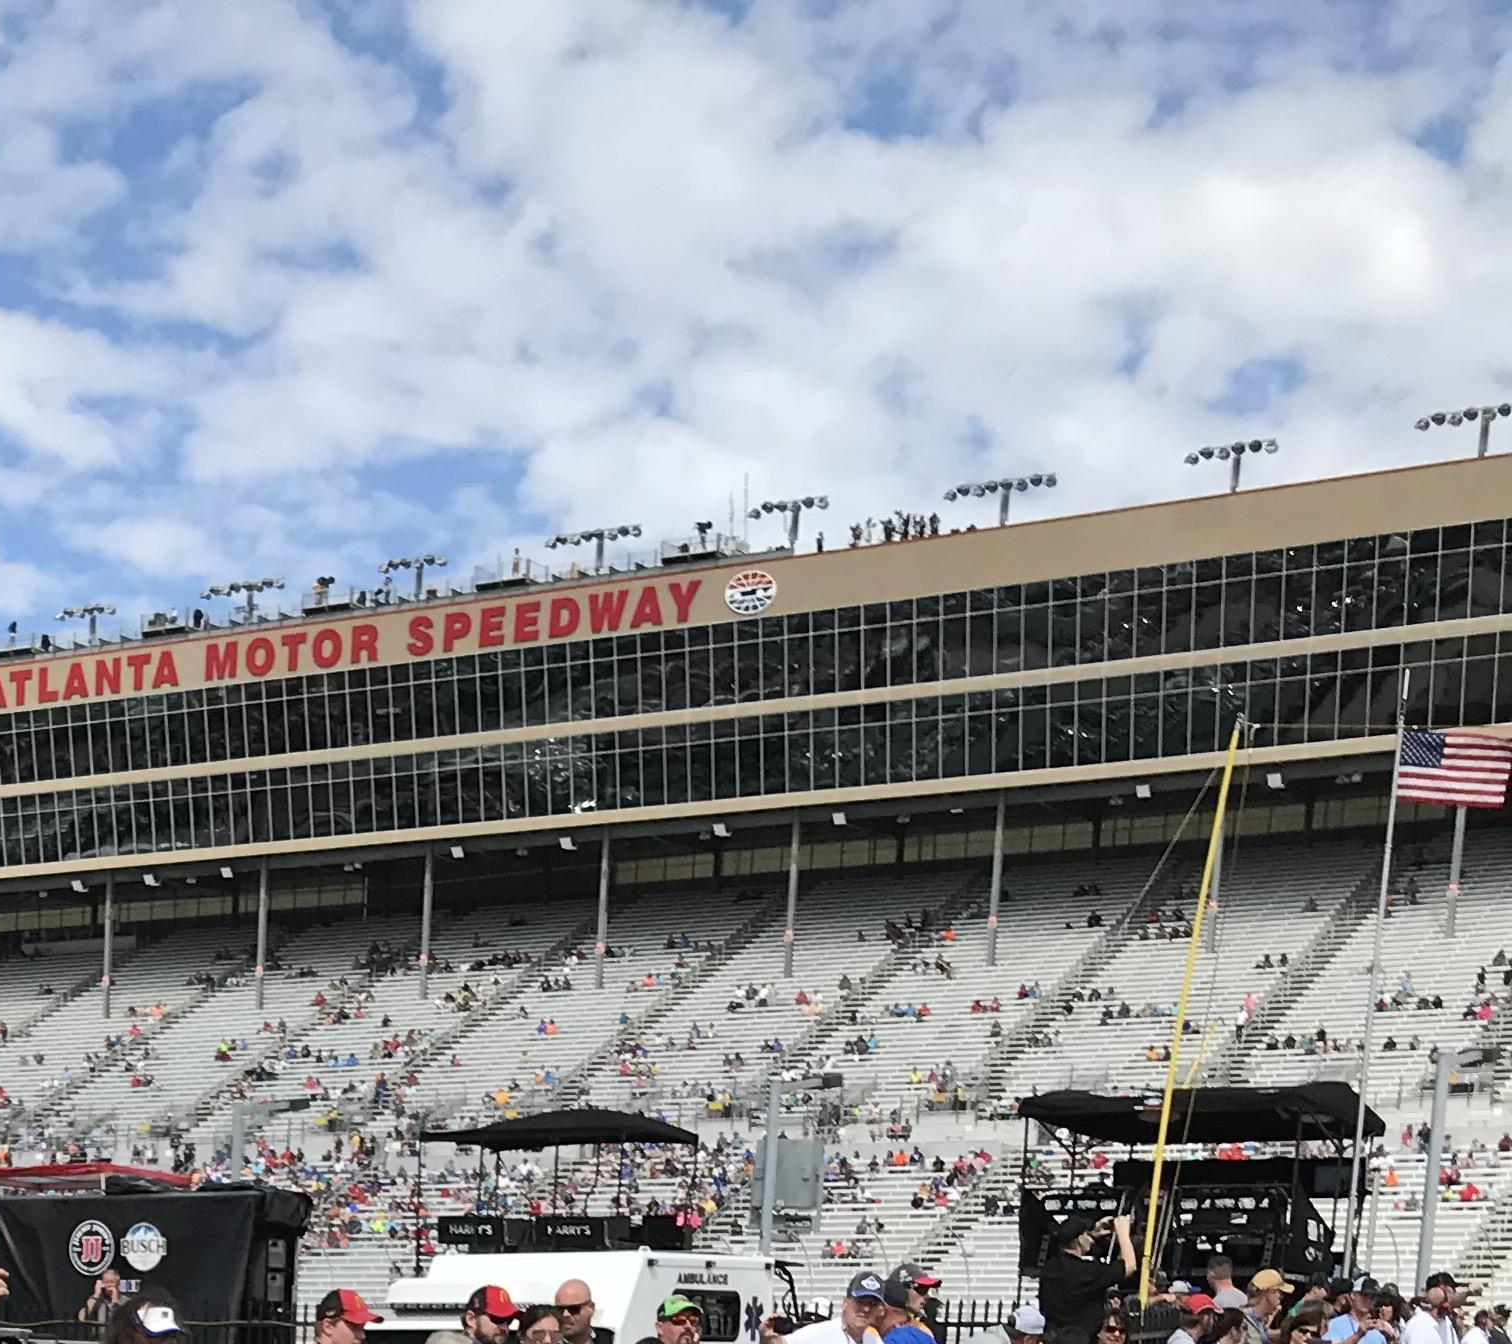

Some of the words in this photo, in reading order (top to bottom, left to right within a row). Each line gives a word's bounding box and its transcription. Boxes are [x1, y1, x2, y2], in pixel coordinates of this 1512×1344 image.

[204, 622, 380, 681] MOTOR
[408, 579, 704, 658] SPEEDWAY
[119, 1238, 168, 1256] BUSCH
[677, 1272, 728, 1285] AMBULANCE
